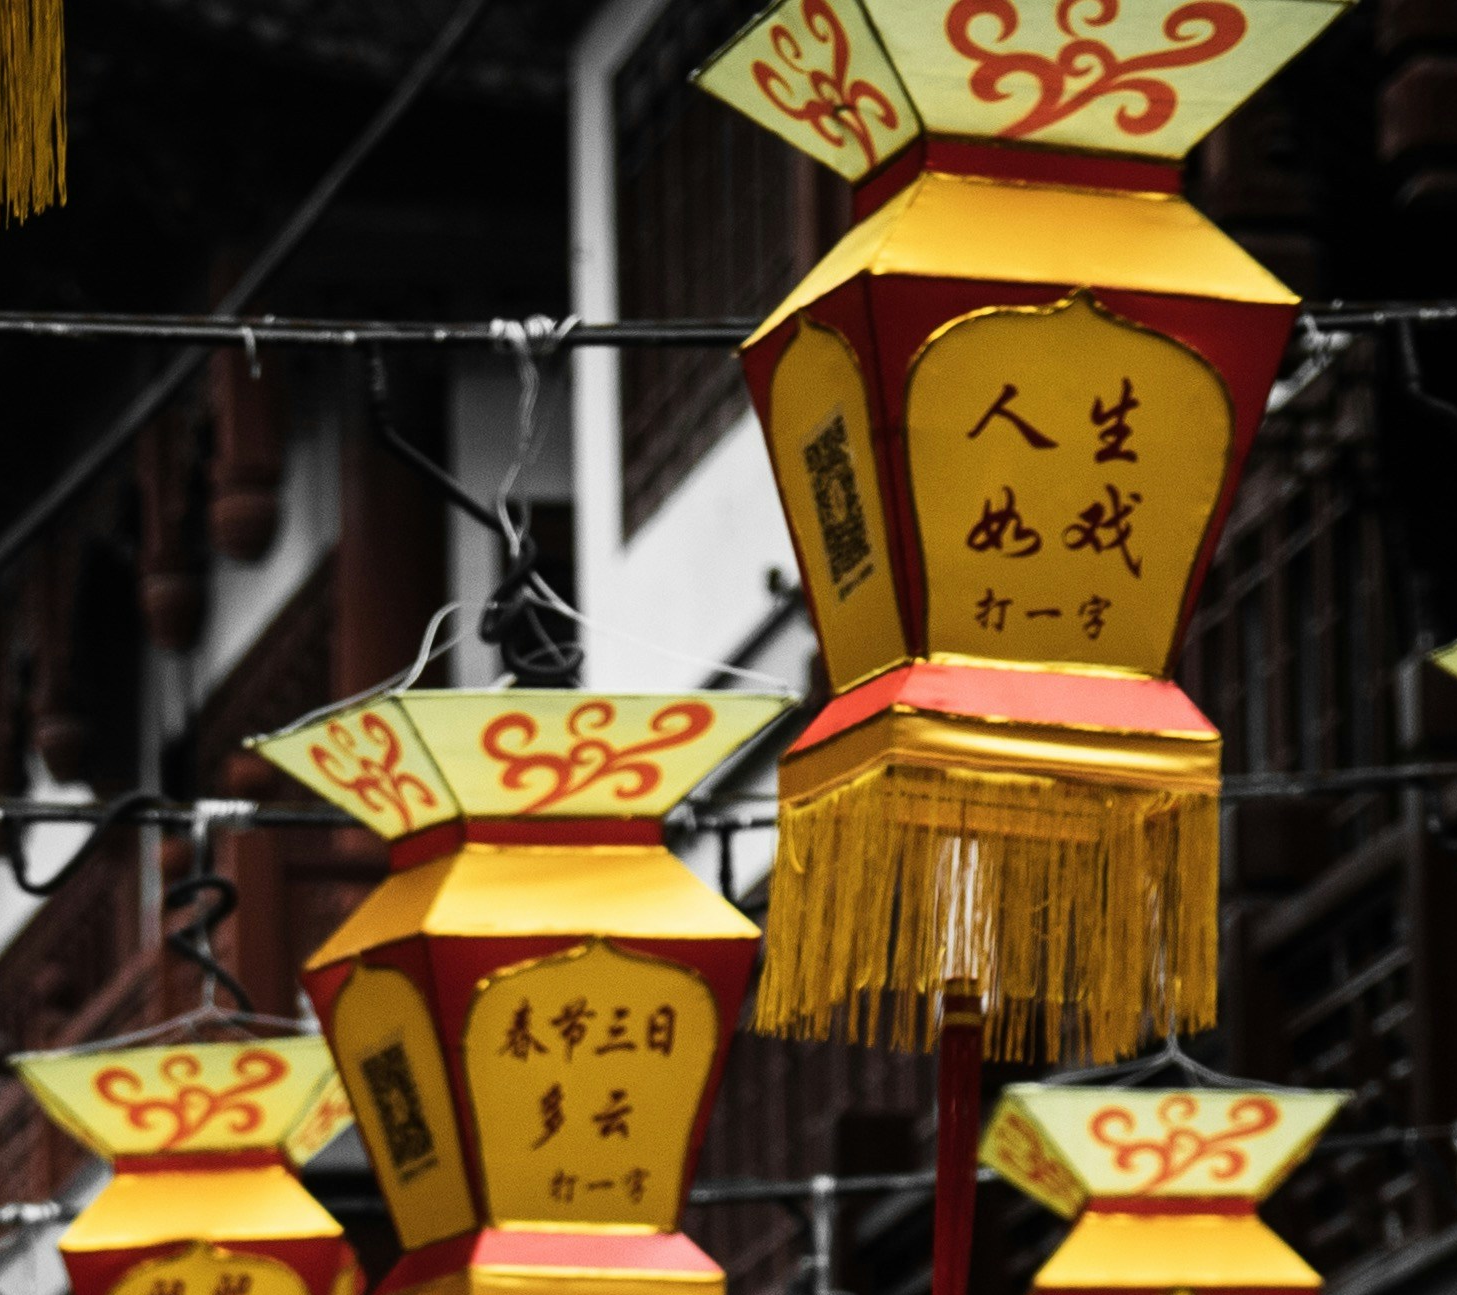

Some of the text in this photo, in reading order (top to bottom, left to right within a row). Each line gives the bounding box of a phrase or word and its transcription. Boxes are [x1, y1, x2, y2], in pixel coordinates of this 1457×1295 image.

[966, 379, 1142, 465] 人生
[966, 486, 1143, 578] 如戏
[974, 588, 1112, 639] 打一字
[497, 997, 678, 1062] 春节三日
[530, 1090, 634, 1150] 多云
[550, 1167, 651, 1206] 打一字
